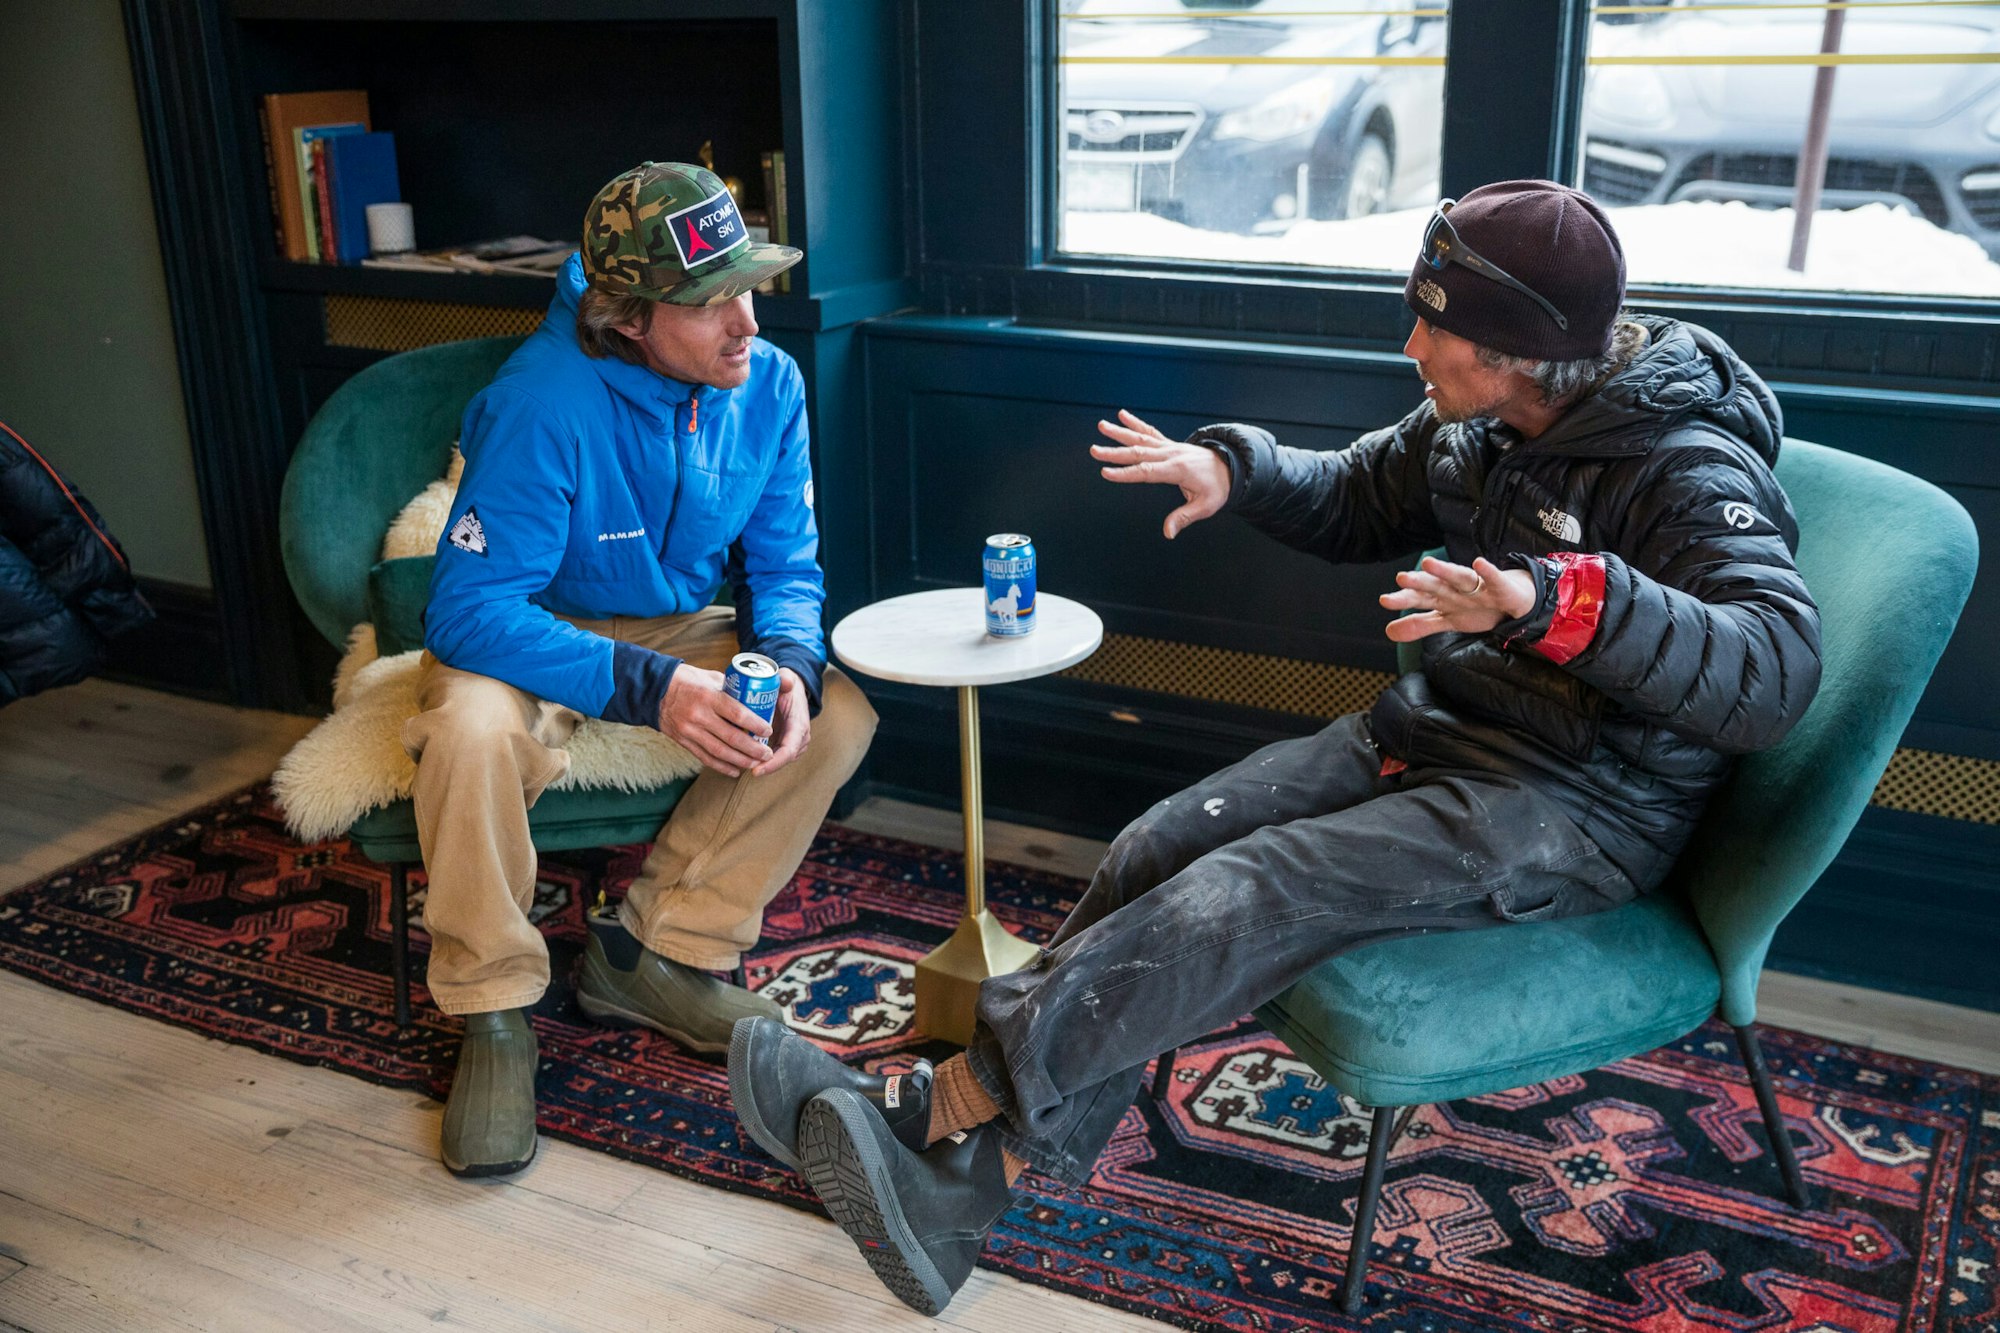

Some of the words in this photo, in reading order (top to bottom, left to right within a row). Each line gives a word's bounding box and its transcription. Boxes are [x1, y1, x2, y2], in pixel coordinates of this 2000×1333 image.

[699, 202, 734, 231] ATOMIC
[718, 221, 735, 239] SKI
[1537, 509, 1564, 530] NORTH
[1550, 508, 1567, 521] THE
[598, 527, 646, 542] MAMMU
[1542, 520, 1562, 539] FACE
